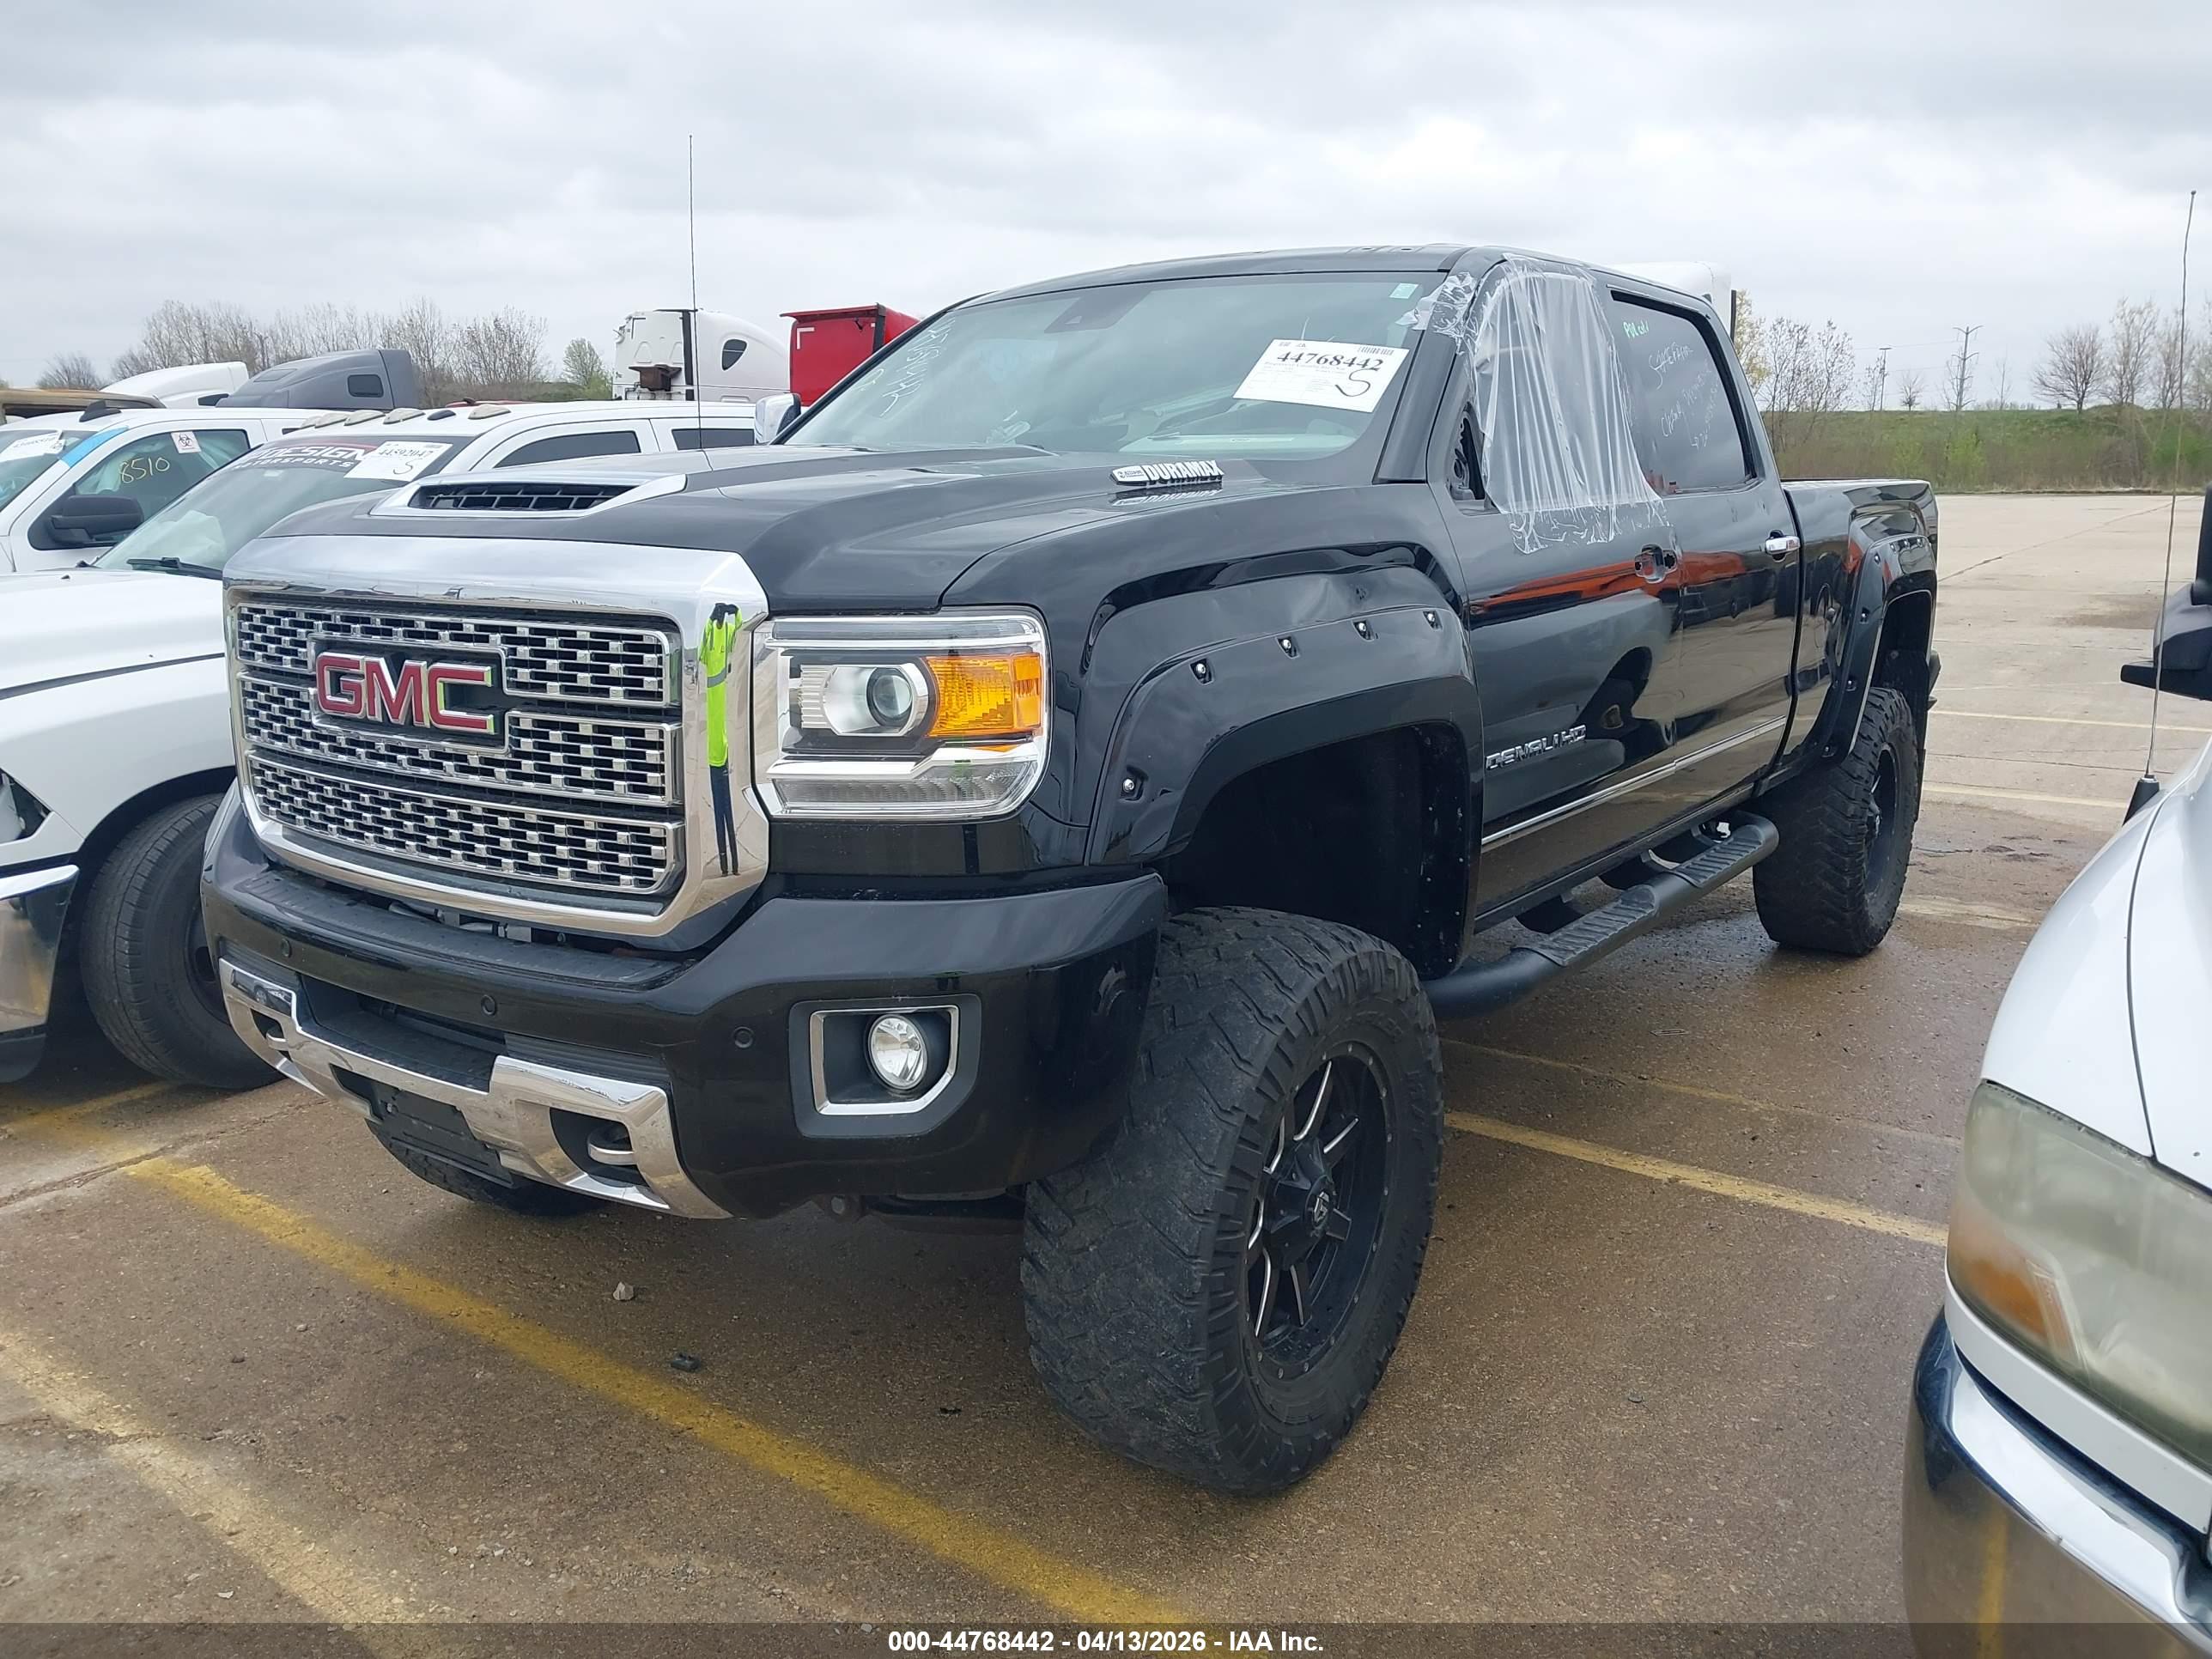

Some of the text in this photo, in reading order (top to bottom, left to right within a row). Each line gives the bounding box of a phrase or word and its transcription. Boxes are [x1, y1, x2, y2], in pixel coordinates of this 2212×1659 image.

[1277, 350, 1383, 372] 44768442
[119, 456, 171, 483] 8510
[1143, 459, 1225, 482] DURAMAX
[316, 651, 495, 736] GMC
[1485, 724, 1587, 770] DENALI HD
